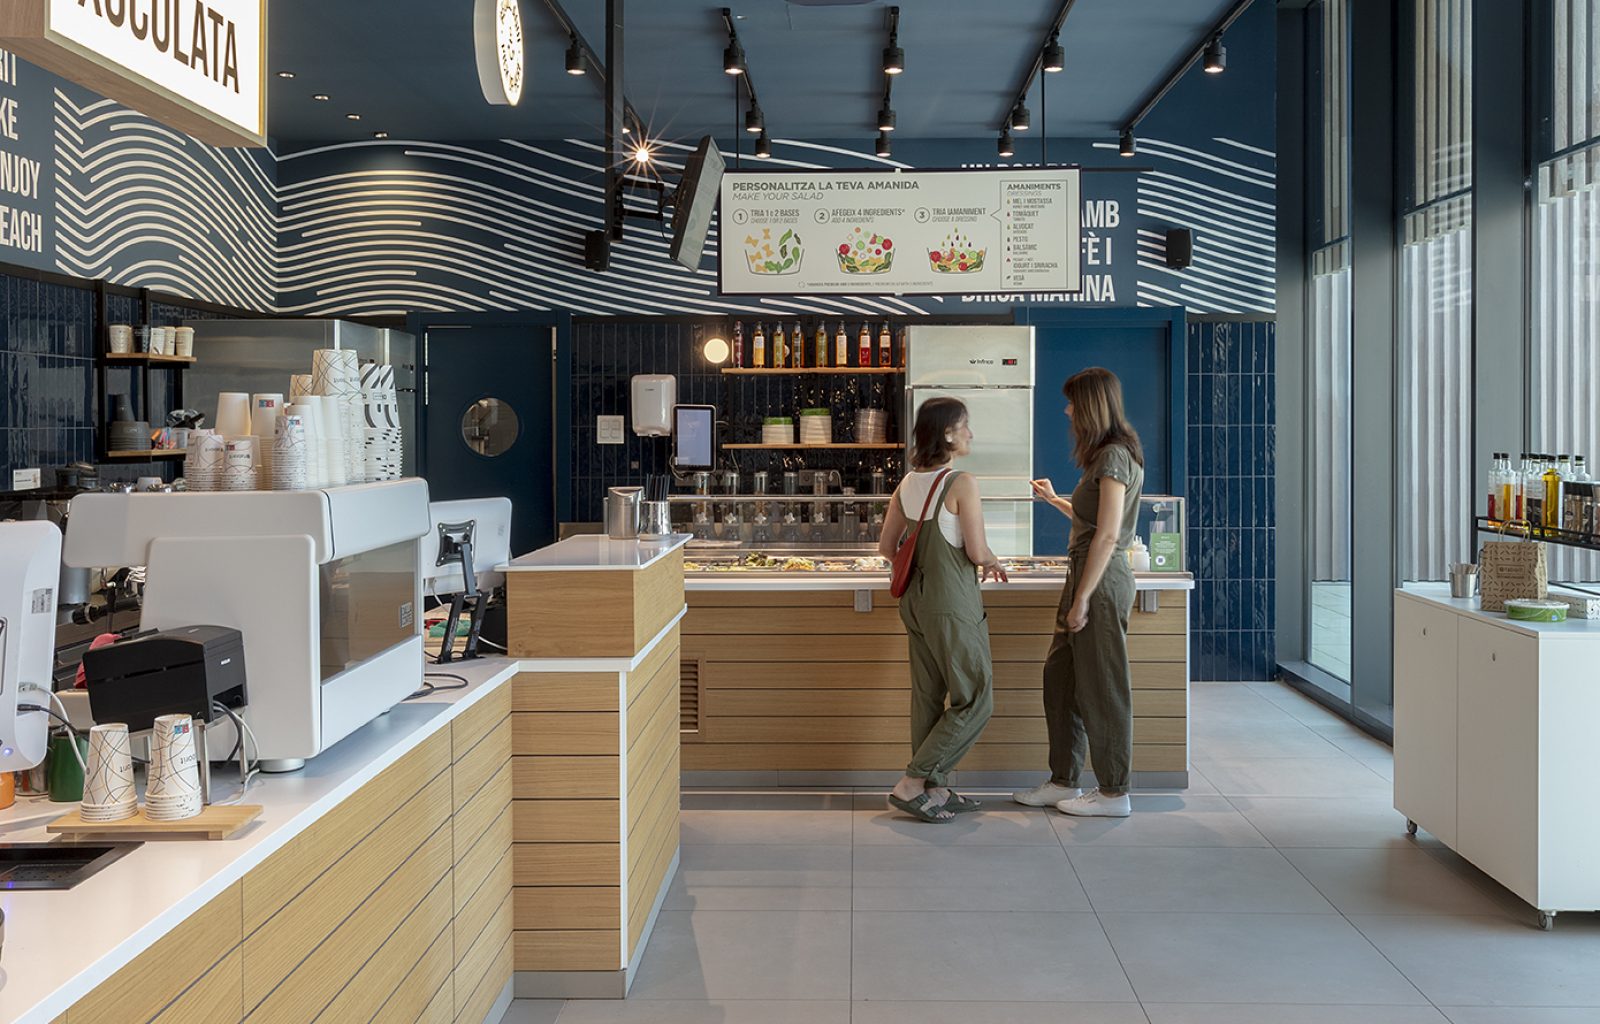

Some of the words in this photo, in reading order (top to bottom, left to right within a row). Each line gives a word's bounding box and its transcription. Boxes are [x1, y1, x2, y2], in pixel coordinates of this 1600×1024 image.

[732, 182, 814, 191] PERSONALITZA
[818, 181, 833, 191] LA
[836, 181, 865, 190] TEVA
[867, 181, 920, 190] AMANIDA
[732, 192, 760, 201] MAKE
[762, 192, 790, 201] YOUR
[792, 192, 824, 201] SALAD
[780, 209, 800, 217] BASES
[1106, 237, 1112, 265] I
